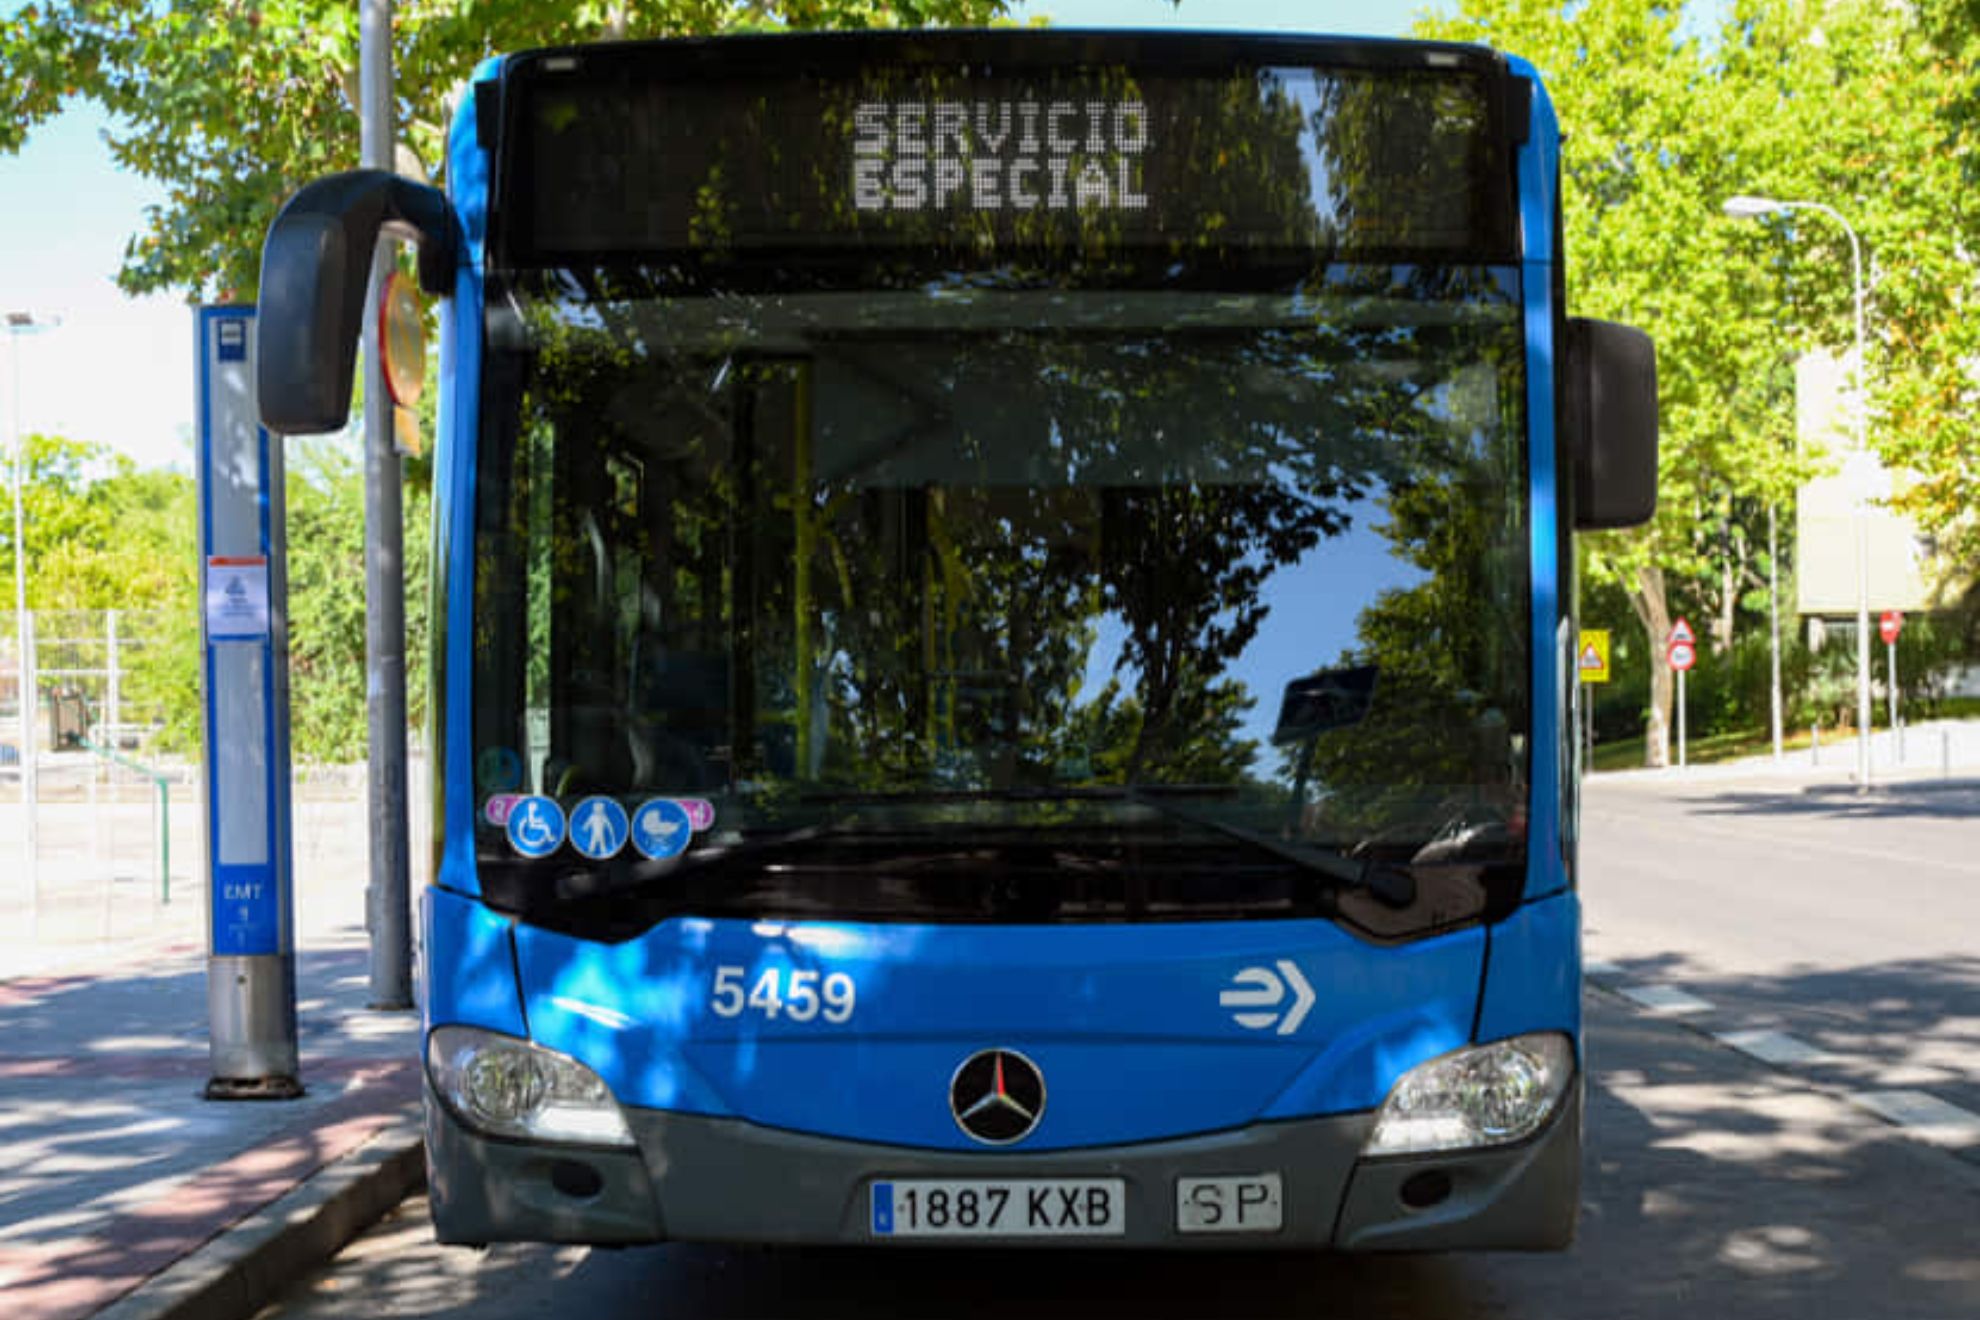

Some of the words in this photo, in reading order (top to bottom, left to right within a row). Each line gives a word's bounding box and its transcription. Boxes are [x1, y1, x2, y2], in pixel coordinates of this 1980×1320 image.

[854, 102, 1148, 153] SERVICIO
[854, 158, 1148, 209] ESPECIAL
[711, 965, 856, 1024] 5459
[905, 1188, 1010, 1229] 1887
[1028, 1186, 1111, 1228] KXB
